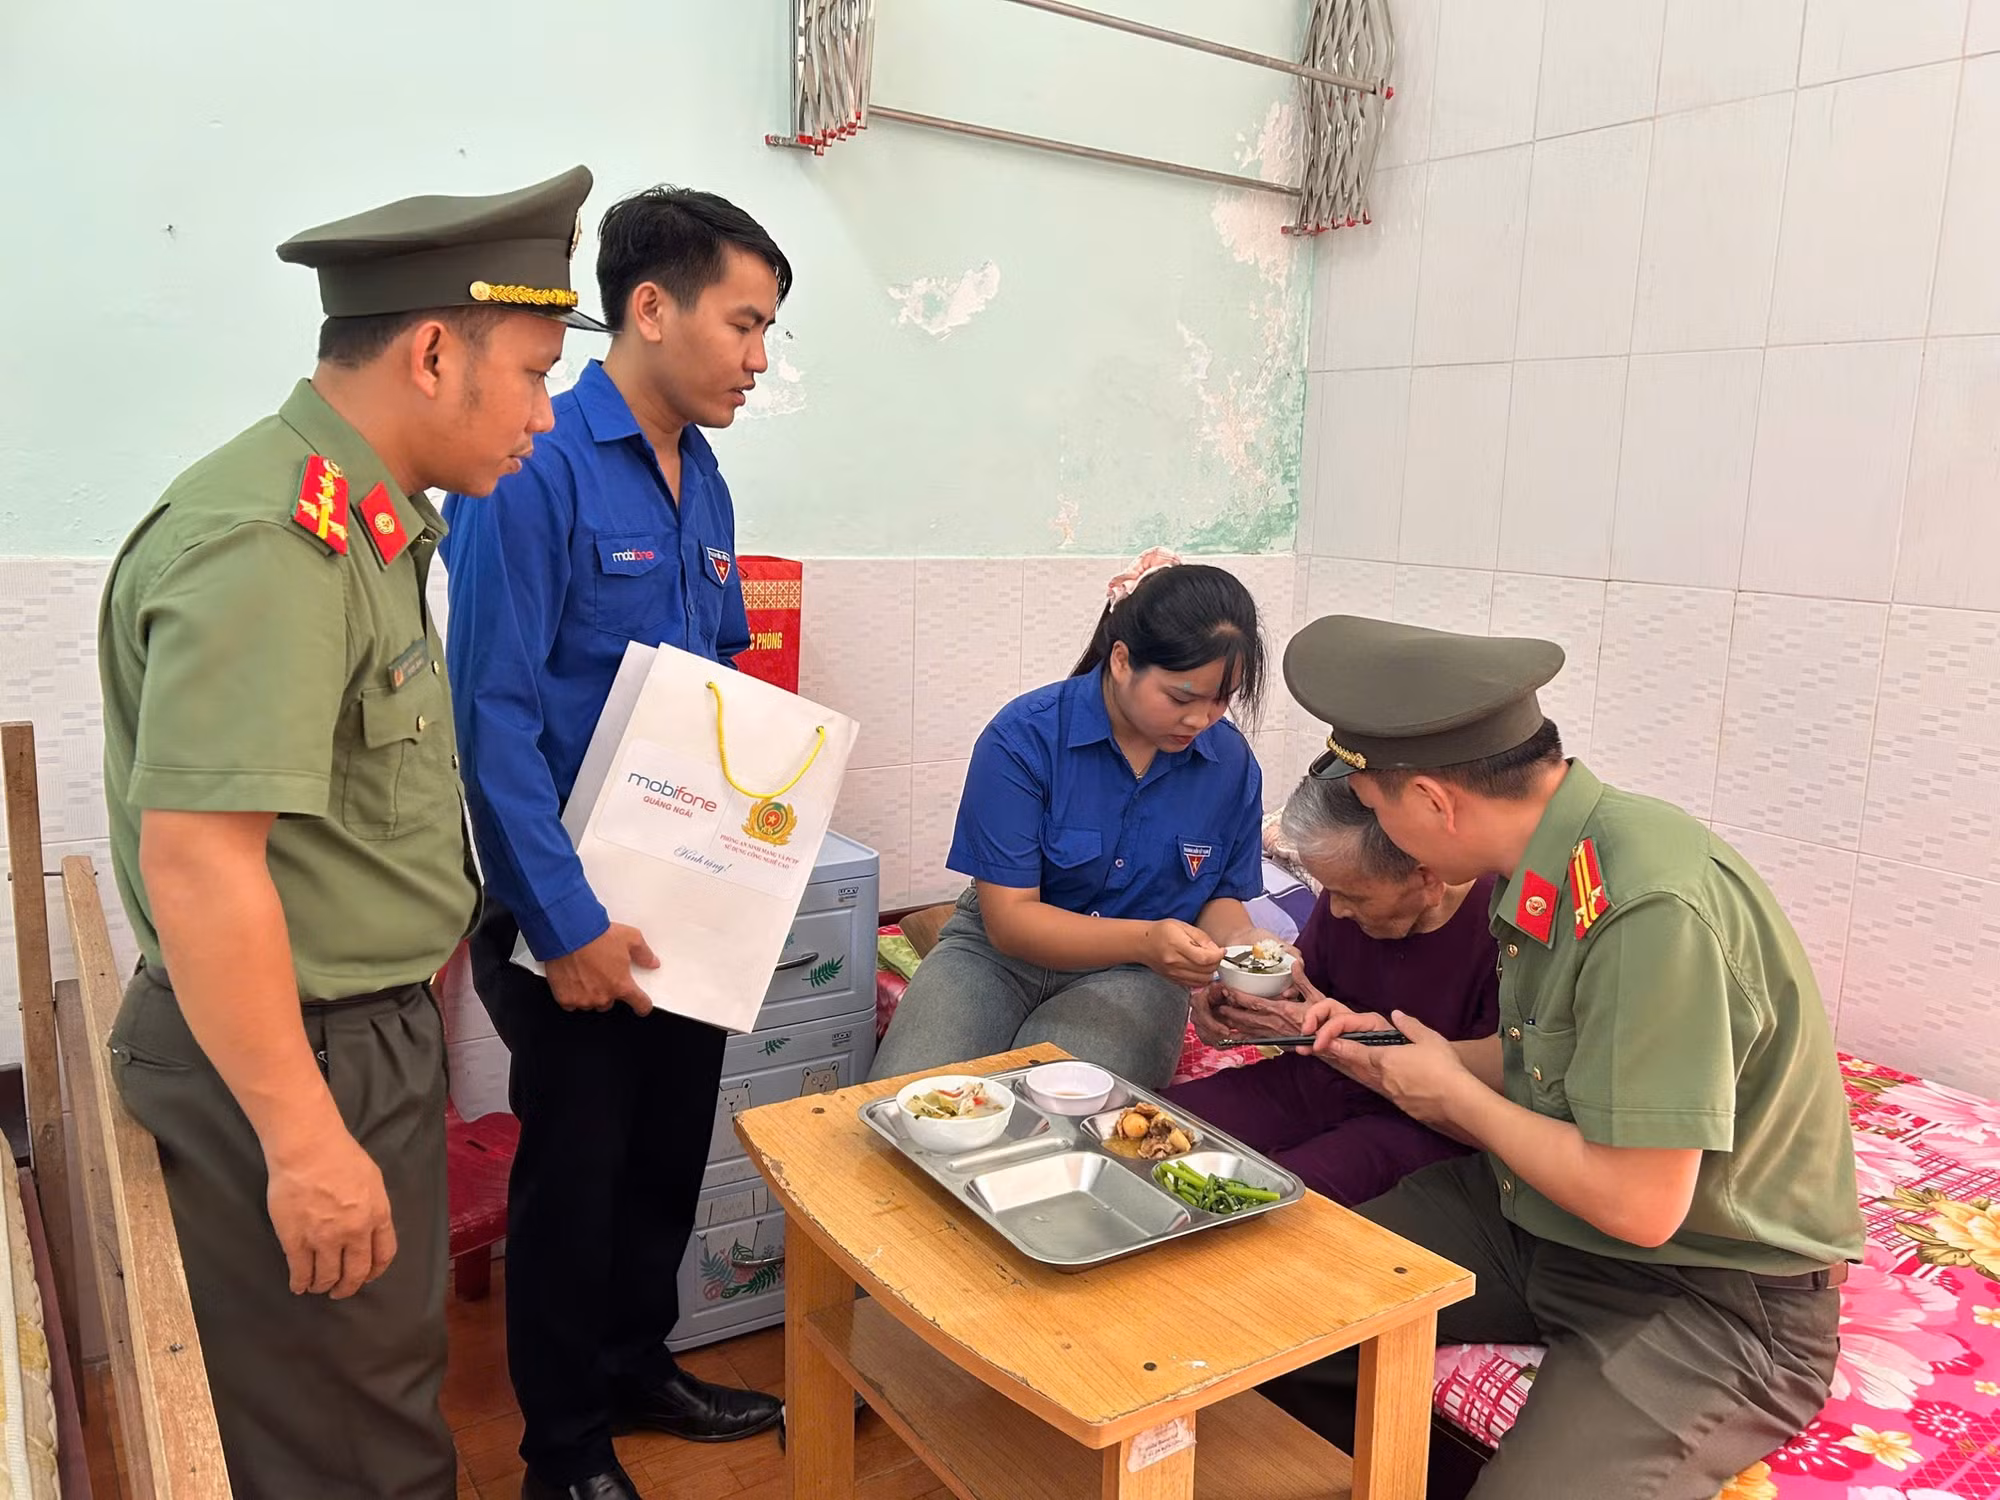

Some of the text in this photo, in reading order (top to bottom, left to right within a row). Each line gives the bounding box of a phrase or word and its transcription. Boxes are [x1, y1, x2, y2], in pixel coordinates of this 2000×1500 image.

[612, 548, 655, 562] mobifone
[756, 628, 783, 650] PHÒNG
[627, 772, 717, 813] mobifone
